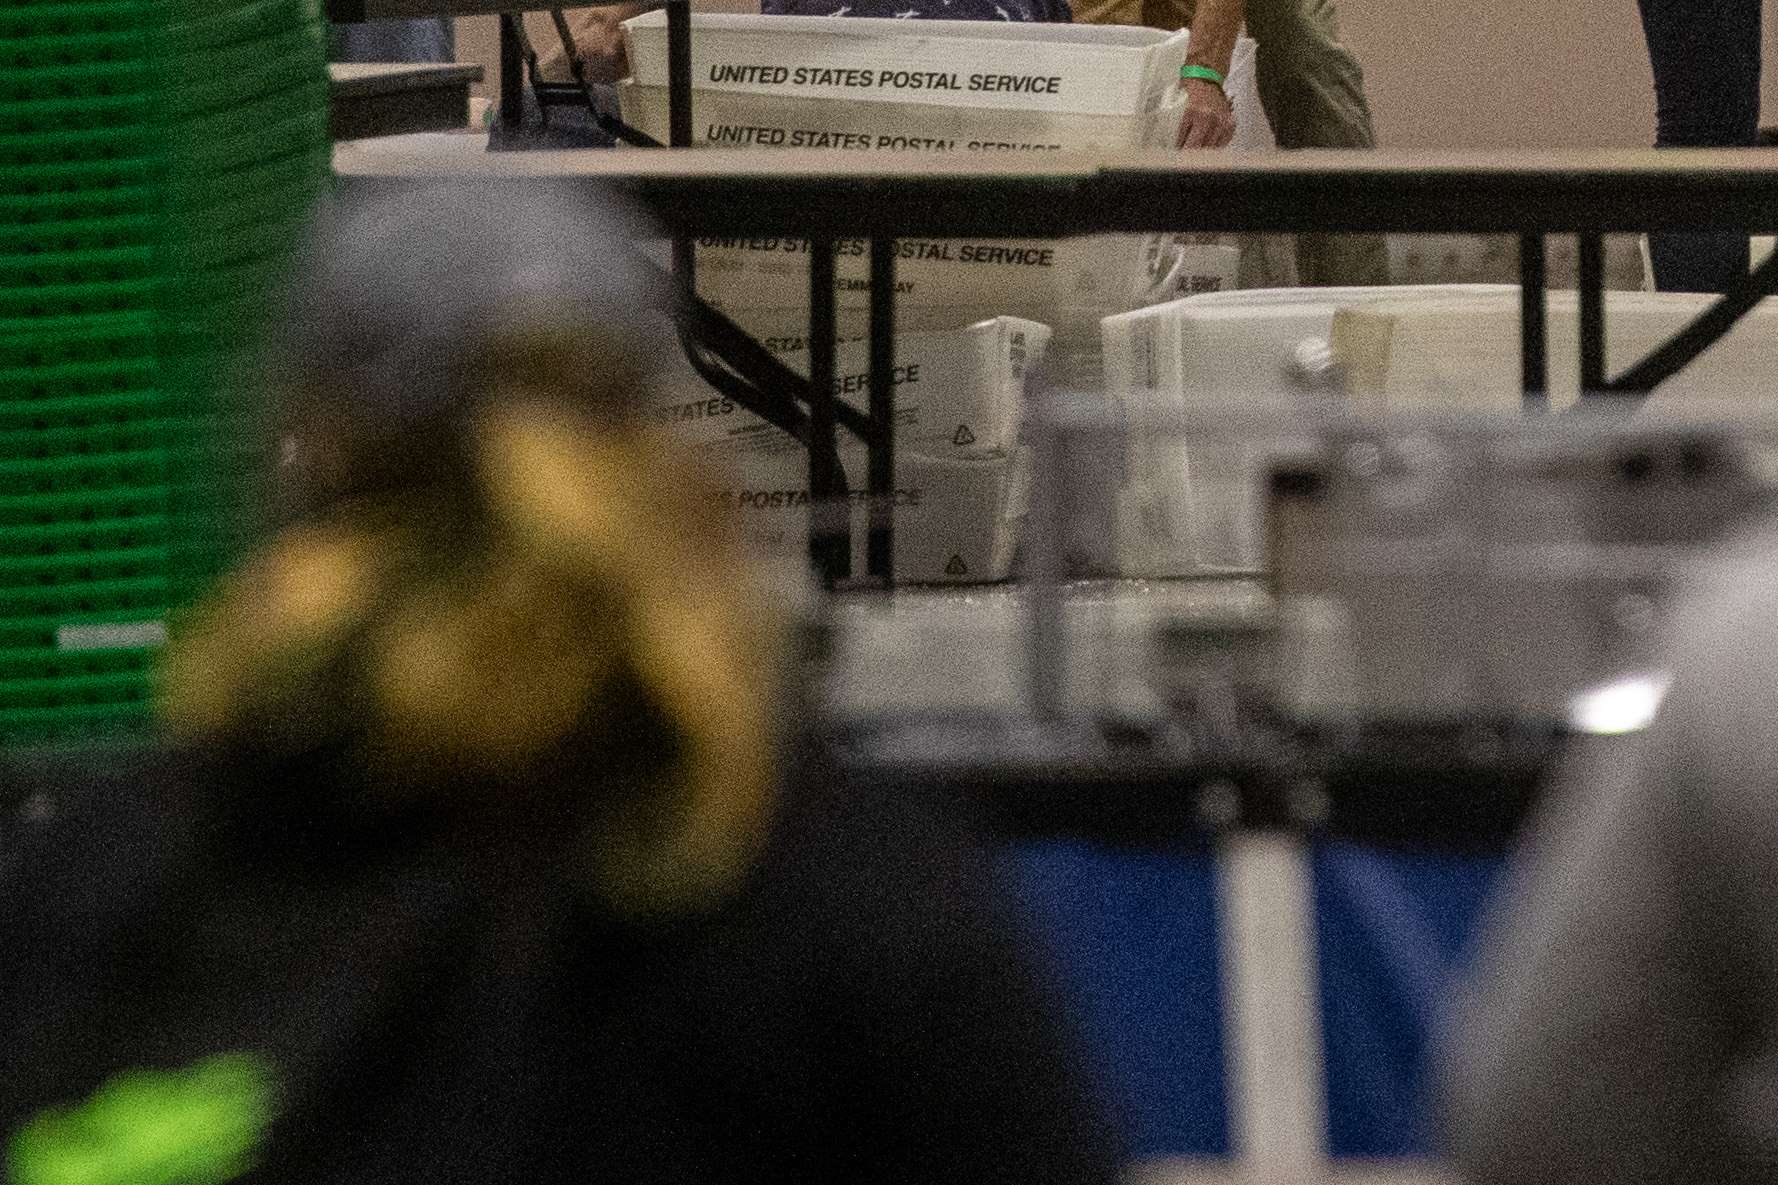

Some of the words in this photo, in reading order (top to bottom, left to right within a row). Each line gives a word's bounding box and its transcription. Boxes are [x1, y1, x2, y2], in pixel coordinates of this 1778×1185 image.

[709, 65, 788, 84] UNITED
[793, 68, 874, 88] STATES
[878, 70, 962, 90] POSTAL
[967, 74, 1062, 94] SERVICE
[707, 124, 785, 146] UNITED
[790, 130, 871, 150] STATES
[784, 239, 867, 257] STES
[896, 242, 954, 262] STAL
[959, 245, 1054, 267] SERVICE
[830, 364, 921, 395] SERCE
[738, 490, 810, 509] POSTA
